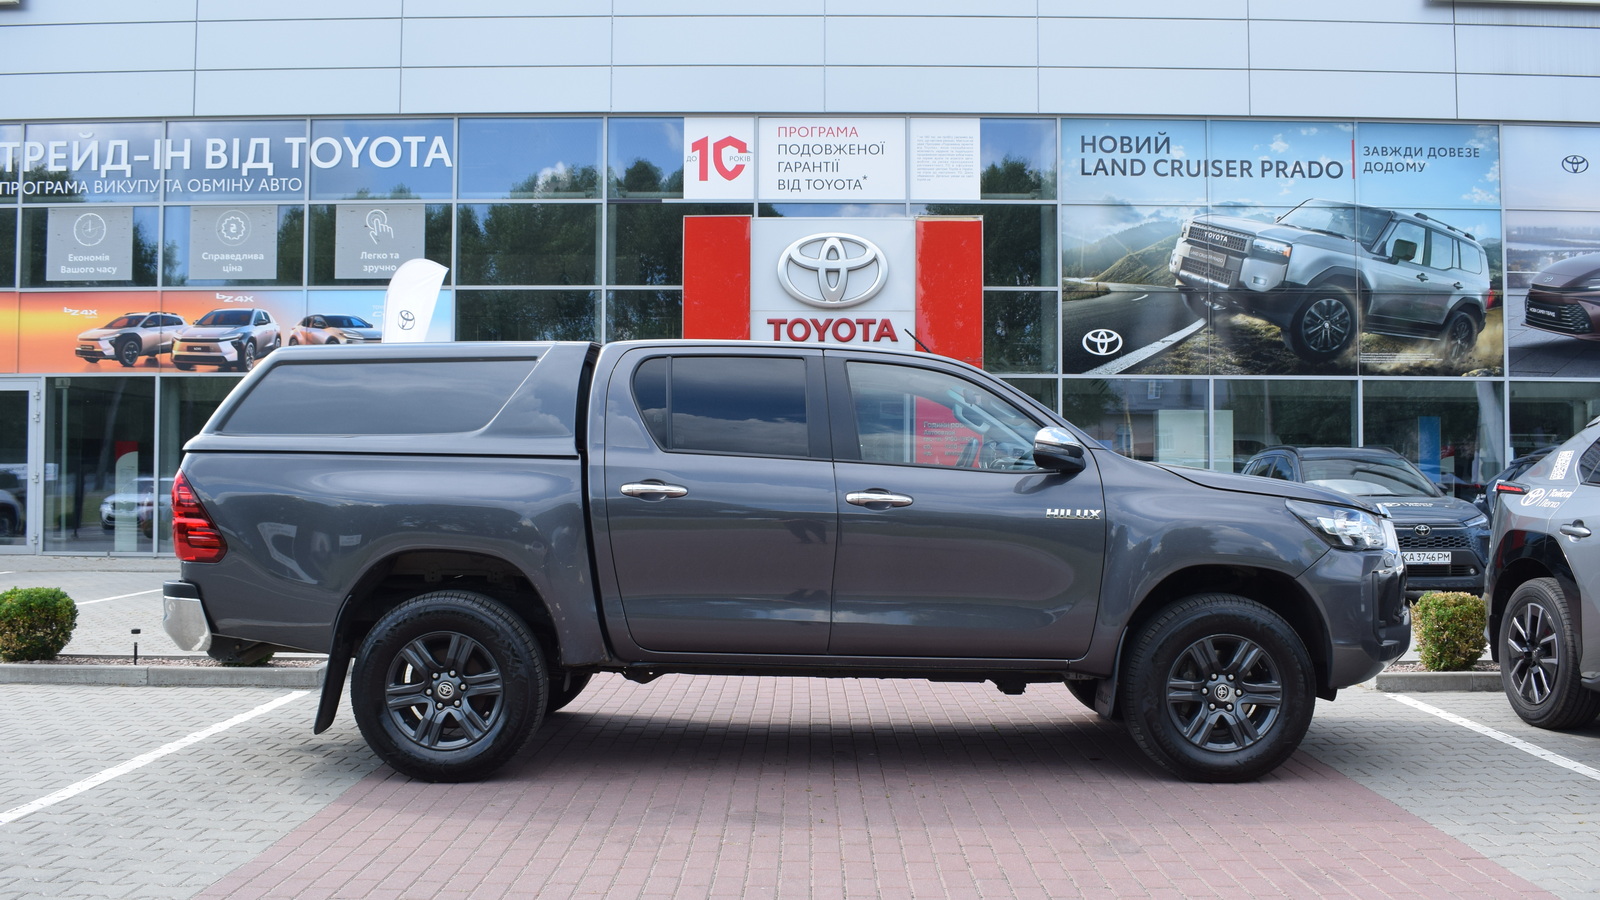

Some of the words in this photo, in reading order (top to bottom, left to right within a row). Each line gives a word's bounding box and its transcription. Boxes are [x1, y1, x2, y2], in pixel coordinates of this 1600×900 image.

[777, 126, 859, 138] ПРОГРАМА
[777, 141, 886, 157] ПОДОВЖЕНОЇ
[1080, 132, 1171, 155] НОВИЙ
[0, 132, 191, 178] ТРЕЙД-ІН
[205, 138, 273, 176] ВІД
[286, 135, 453, 170] TOYOTA
[691, 135, 747, 182] 10
[1363, 145, 1424, 159] ЗАВЖДИ
[1427, 145, 1481, 159] ДОВЕЗЕ
[777, 158, 840, 173] ГАРАНТІЇ
[1080, 157, 1146, 177] LAND
[1152, 158, 1254, 178] CRUISER
[1260, 159, 1344, 180] PRADO
[1363, 161, 1427, 175] ДОДОМУ
[0, 180, 89, 195] ПРОГРАМА
[94, 179, 160, 194] ВИКУПУ
[165, 179, 183, 193] ТА
[187, 178, 255, 192] ОБМІНУ
[258, 178, 303, 192] АВТО
[777, 178, 802, 193] ВІД
[1204, 231, 1228, 243] TOYOTA
[67, 253, 110, 262] Економія
[201, 252, 264, 263] Справедлива
[360, 252, 387, 261] Легко
[389, 252, 400, 260] та
[60, 265, 93, 275] Вашого
[95, 267, 117, 276] часу
[222, 263, 243, 274] ціна
[363, 264, 397, 273] зручно
[766, 318, 899, 343] TOYOTA
[1046, 508, 1101, 520] HILUX
[1417, 552, 1436, 562] 3746
[1437, 552, 1450, 562] PM
